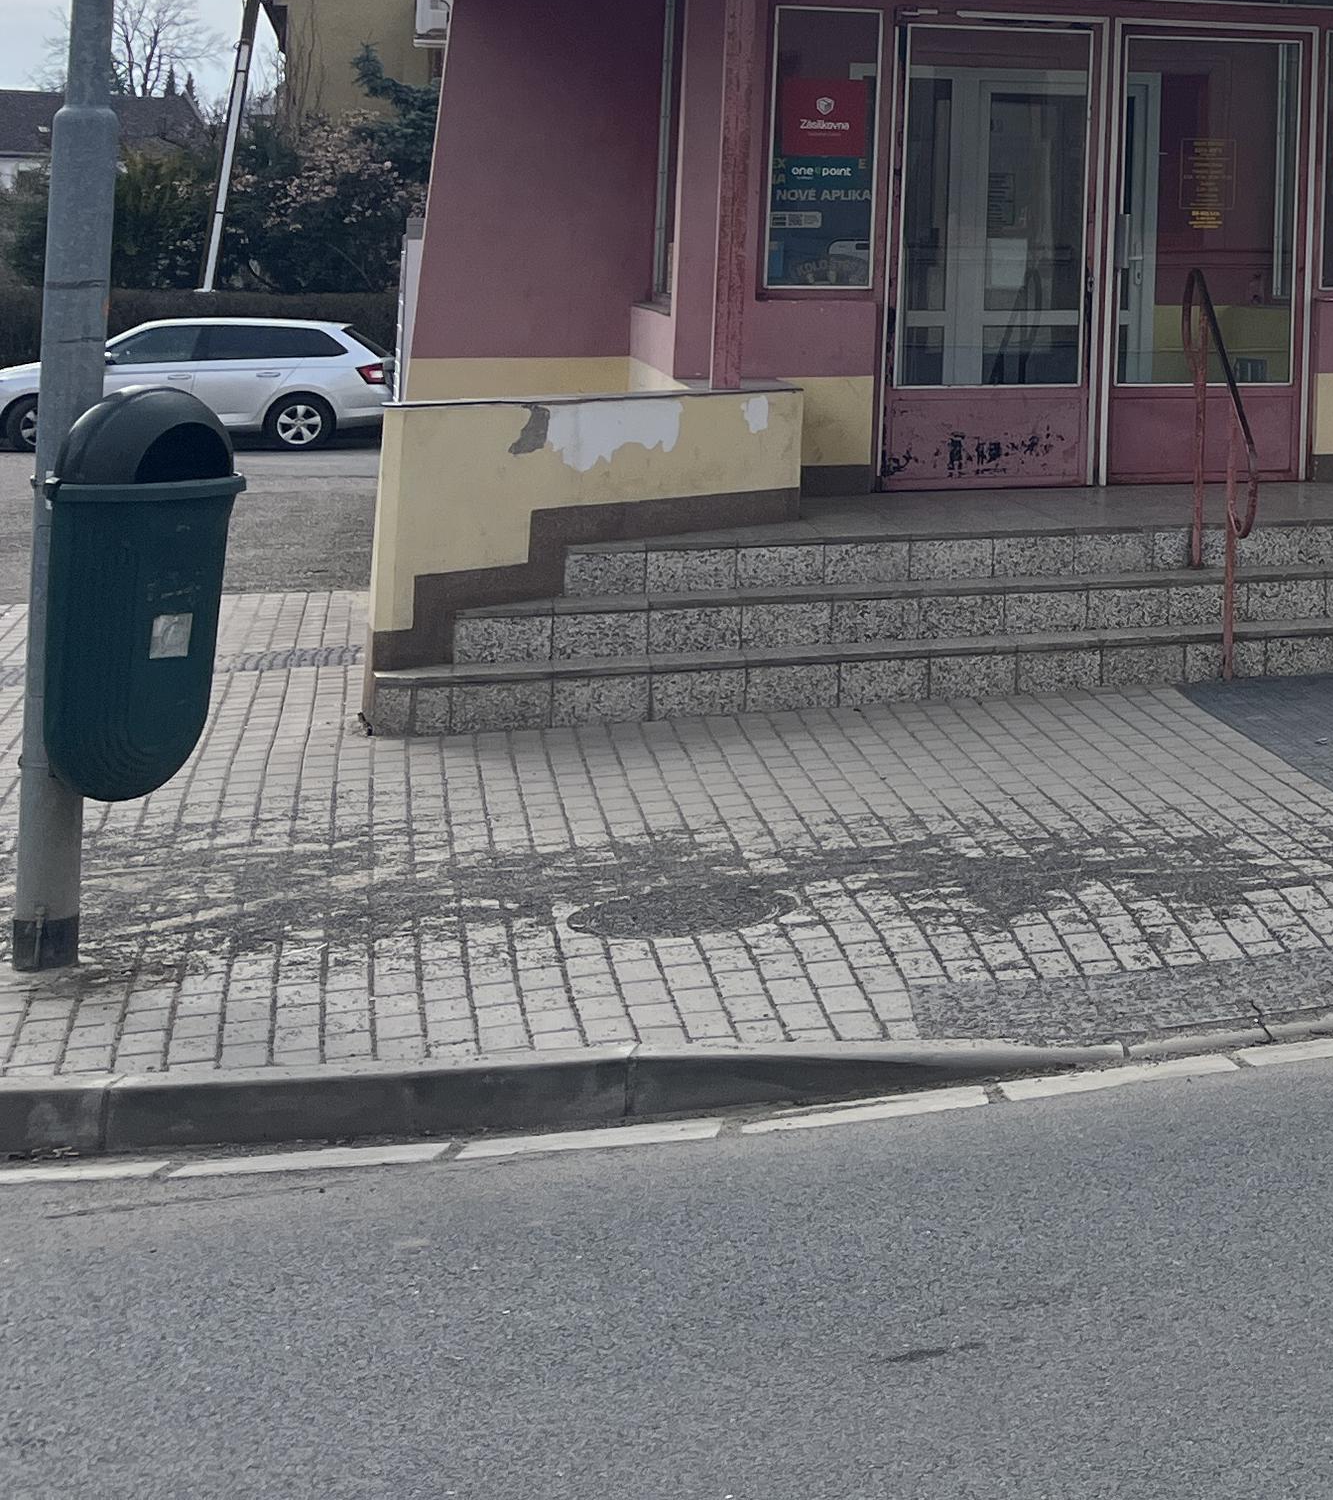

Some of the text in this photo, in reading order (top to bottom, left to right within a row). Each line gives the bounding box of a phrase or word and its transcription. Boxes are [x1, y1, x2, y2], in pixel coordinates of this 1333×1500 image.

[800, 118, 850, 131] Zásilkovna
[791, 166, 852, 177] one point
[776, 188, 871, 201] NOVÉ APLIKA
